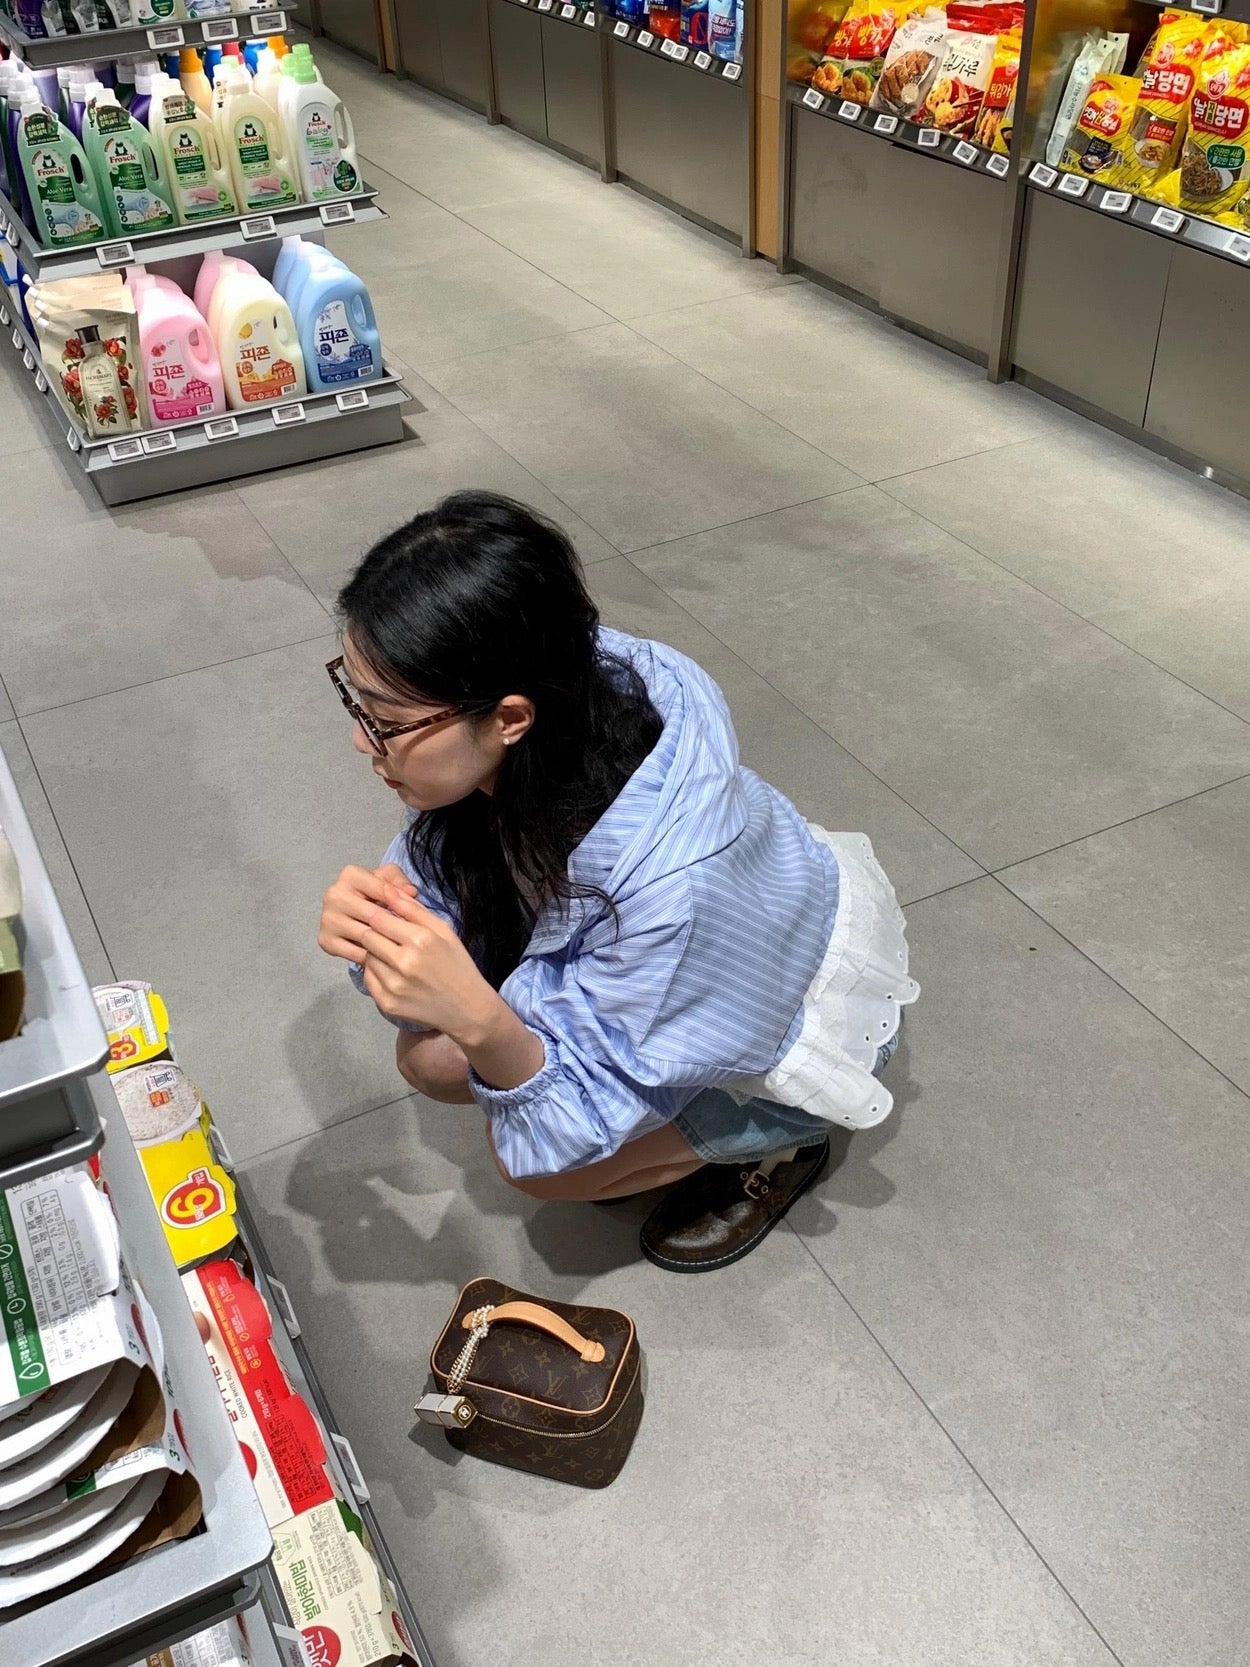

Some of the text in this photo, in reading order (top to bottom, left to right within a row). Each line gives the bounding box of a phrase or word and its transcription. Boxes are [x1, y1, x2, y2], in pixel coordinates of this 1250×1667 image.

[238, 136, 264, 145] Frosch
[173, 145, 200, 155] Frosch
[109, 154, 136, 164] Frosch
[37, 166, 65, 176] Frosch
[318, 328, 349, 344] 피죤
[240, 345, 271, 361] 피죤
[152, 364, 185, 380] 피죤
[169, 1187, 214, 1219] 6
[223, 1368, 233, 1381] RICE
[229, 1381, 240, 1397] WHITE
[288, 1560, 323, 1622] 발아현미밥
